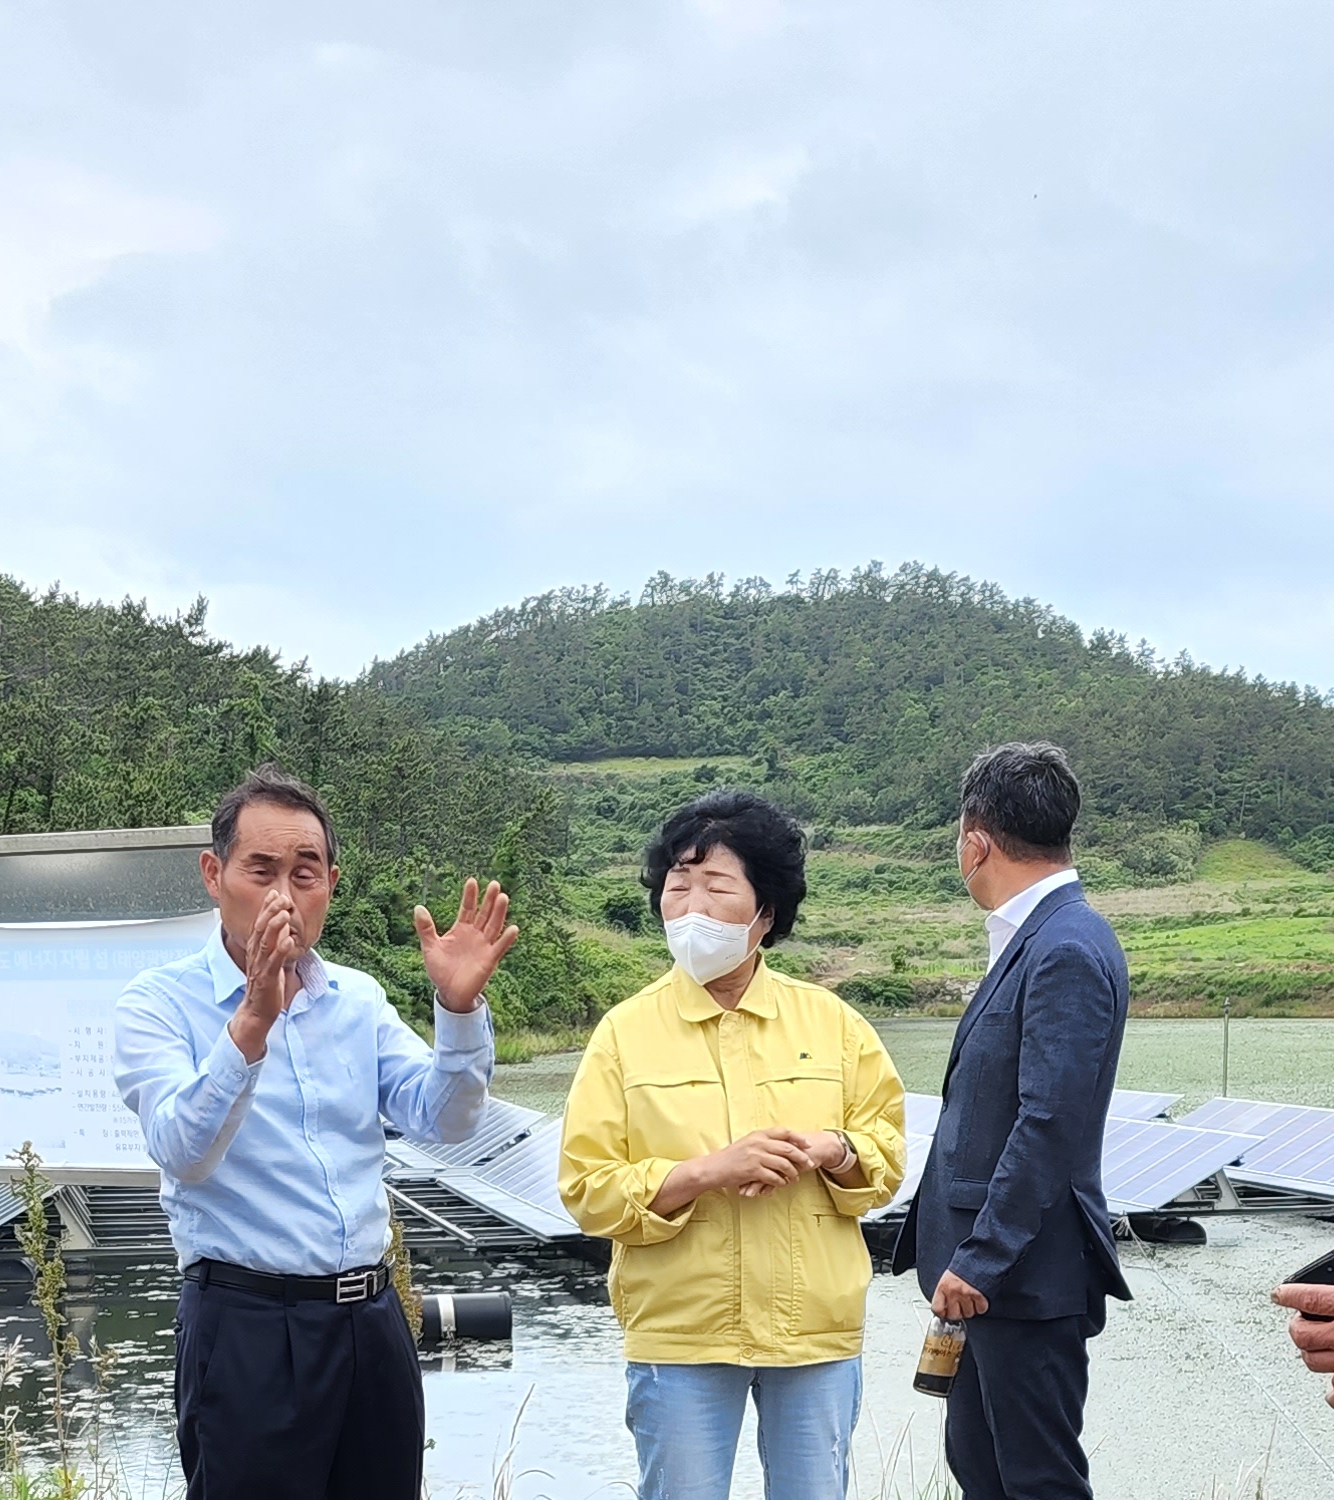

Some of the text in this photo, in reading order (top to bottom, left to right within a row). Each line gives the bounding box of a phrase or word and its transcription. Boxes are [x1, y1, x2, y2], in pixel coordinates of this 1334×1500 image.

[14, 949, 58, 971] 에너지
[60, 948, 90, 971] 자립
[93, 948, 109, 971] 섬
